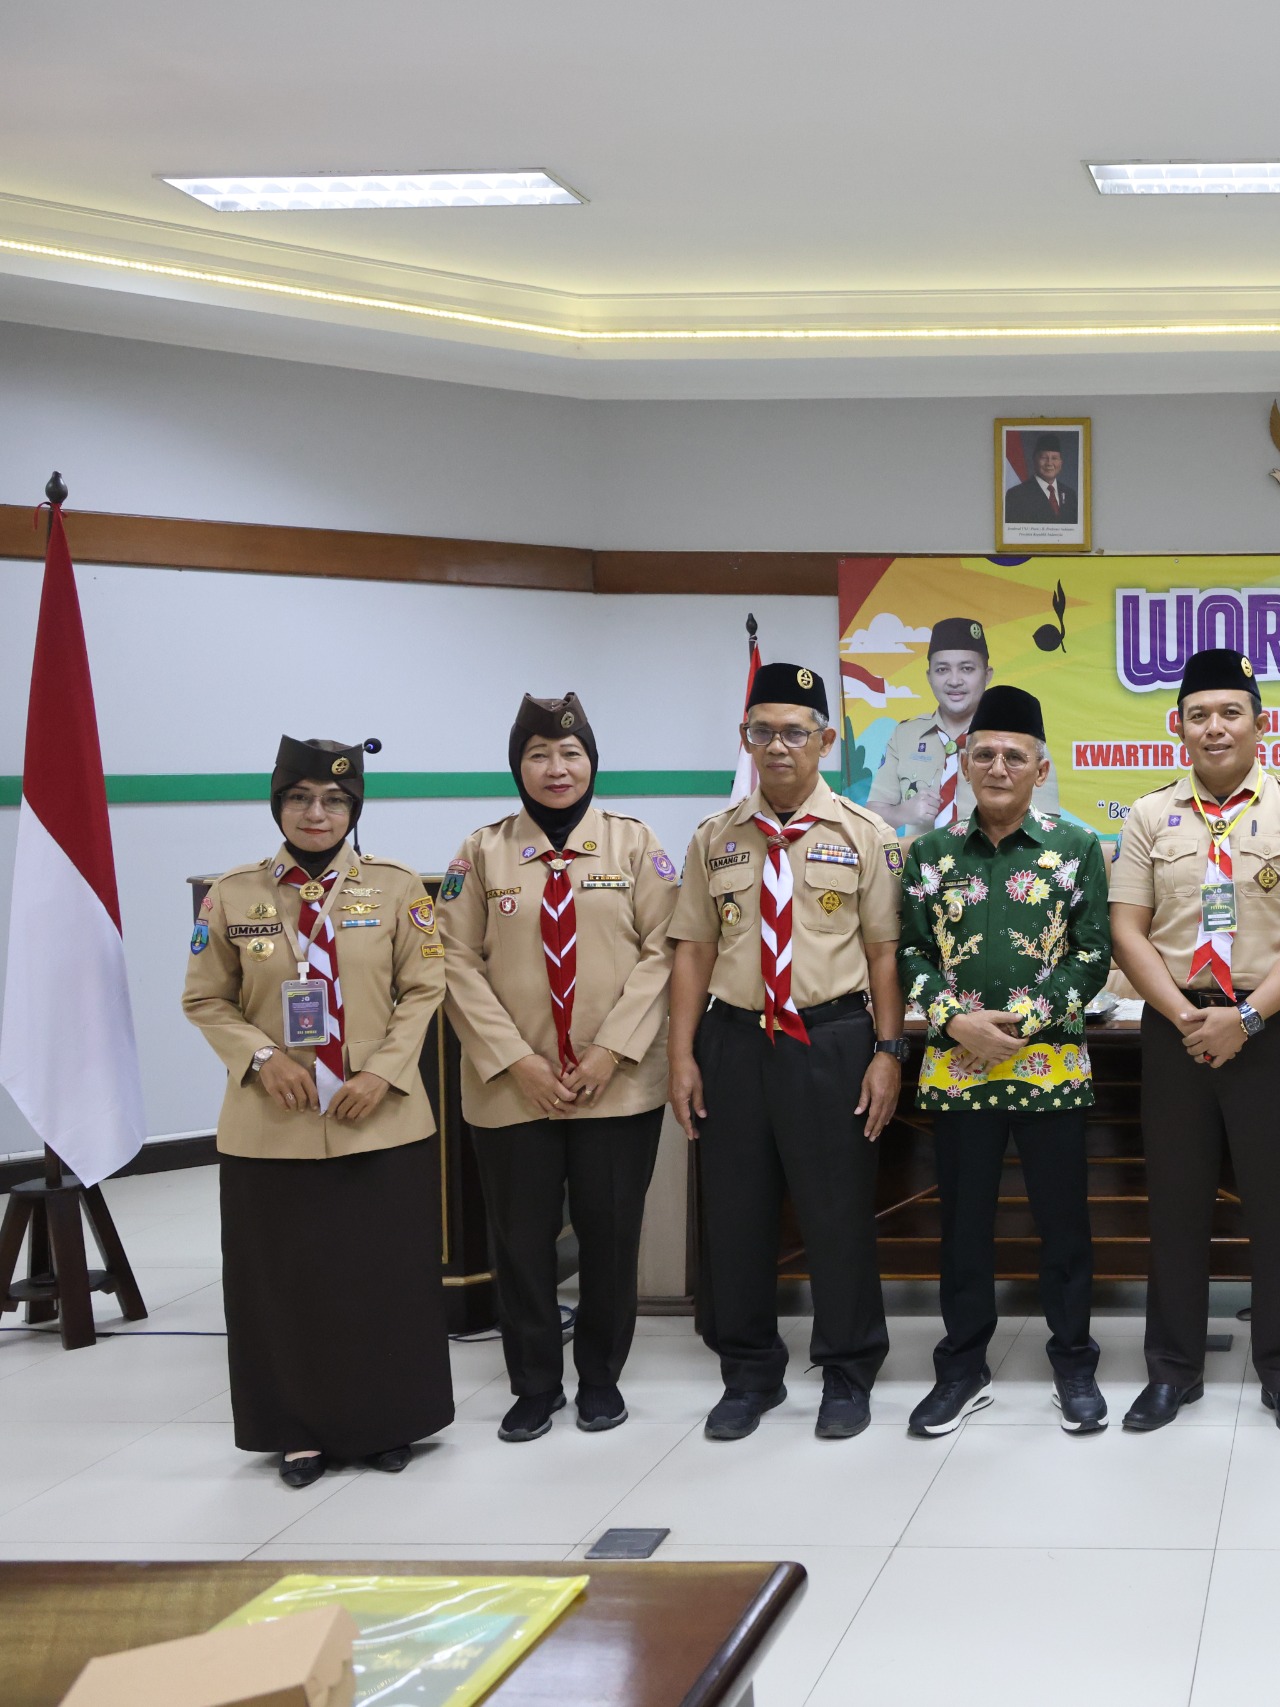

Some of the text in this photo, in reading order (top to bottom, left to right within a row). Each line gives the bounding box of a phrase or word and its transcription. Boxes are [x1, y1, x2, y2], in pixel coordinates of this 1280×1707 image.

[1075, 744, 1174, 766] KWARTIR
[713, 856, 738, 868] ANANG
[230, 925, 279, 935] UMMAH
